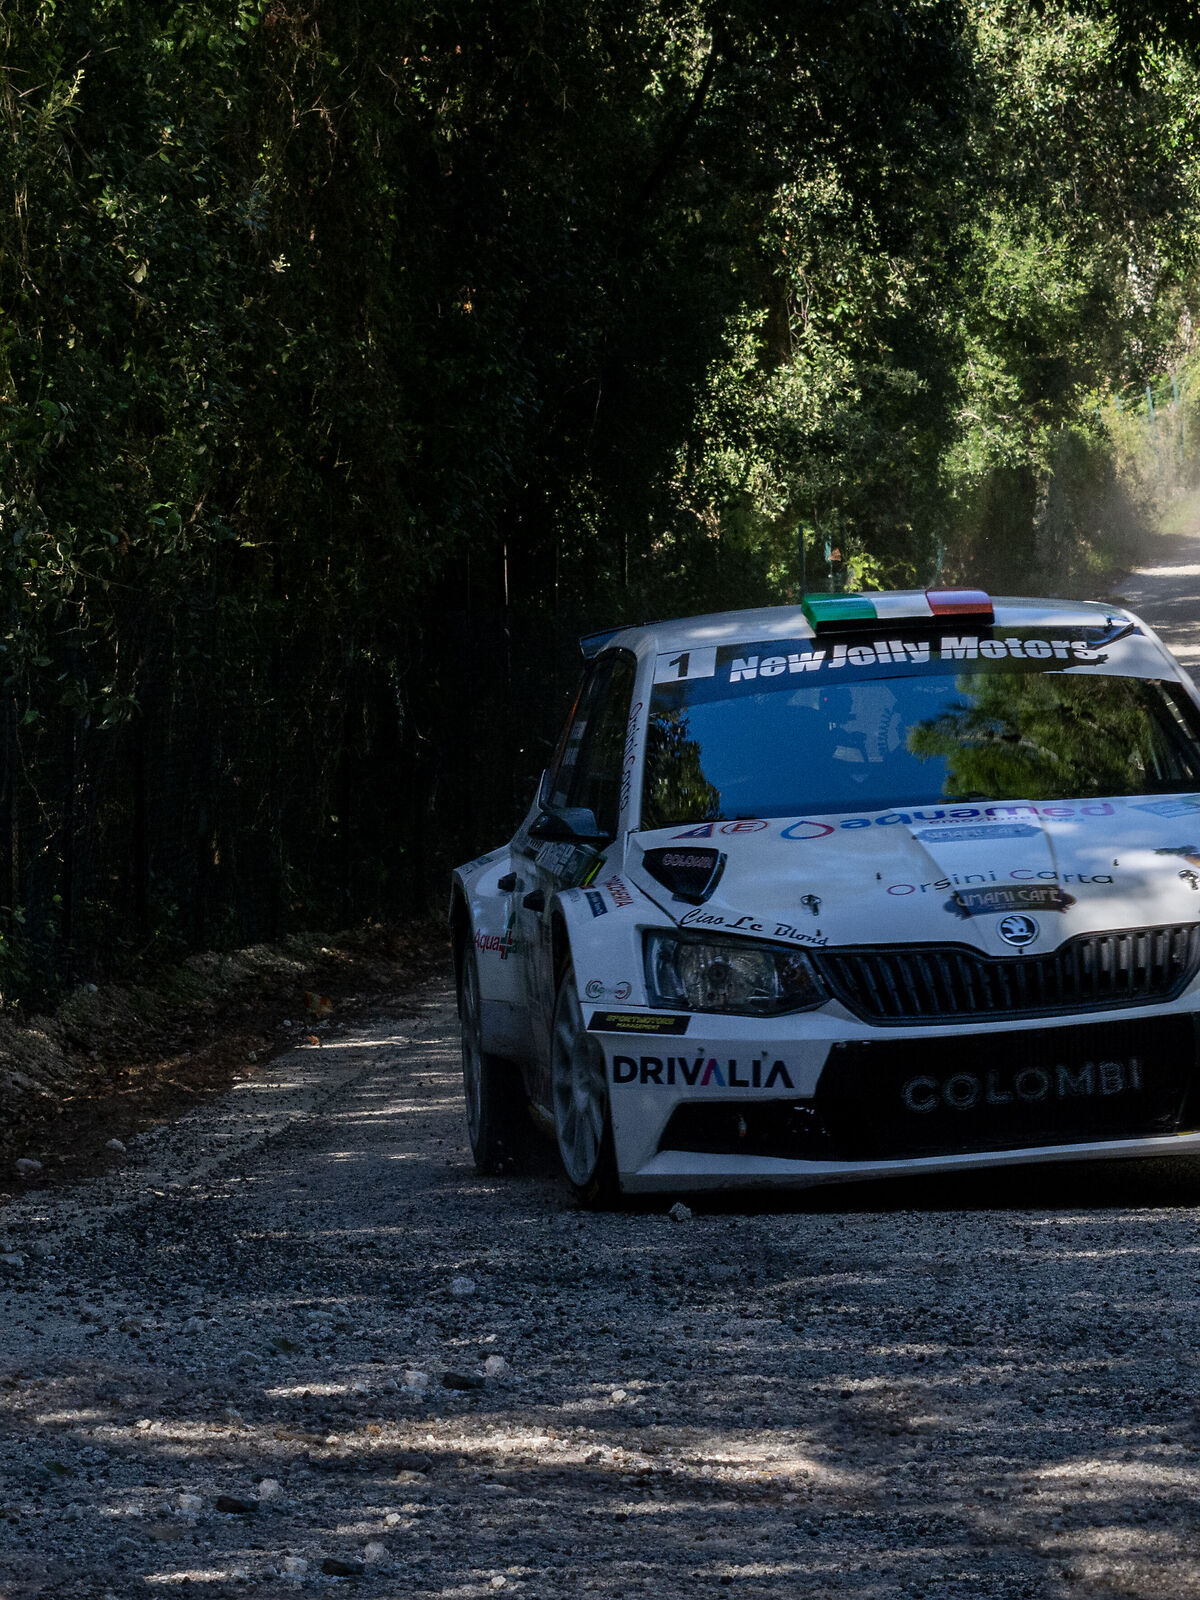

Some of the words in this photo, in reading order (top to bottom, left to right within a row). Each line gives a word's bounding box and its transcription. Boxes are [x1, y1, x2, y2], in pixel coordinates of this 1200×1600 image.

[669, 653, 690, 678] 1
[729, 650, 827, 683] New
[828, 640, 930, 668] Jolly
[940, 636, 1100, 660] Motors
[840, 803, 1115, 830] aquamed
[887, 870, 998, 896] Orsini
[1009, 869, 1114, 884] Carta
[680, 908, 724, 926] Ciao
[773, 922, 829, 946] Blond
[612, 1056, 795, 1089] DRIVALIA
[902, 1058, 1144, 1112] COLOMBI
